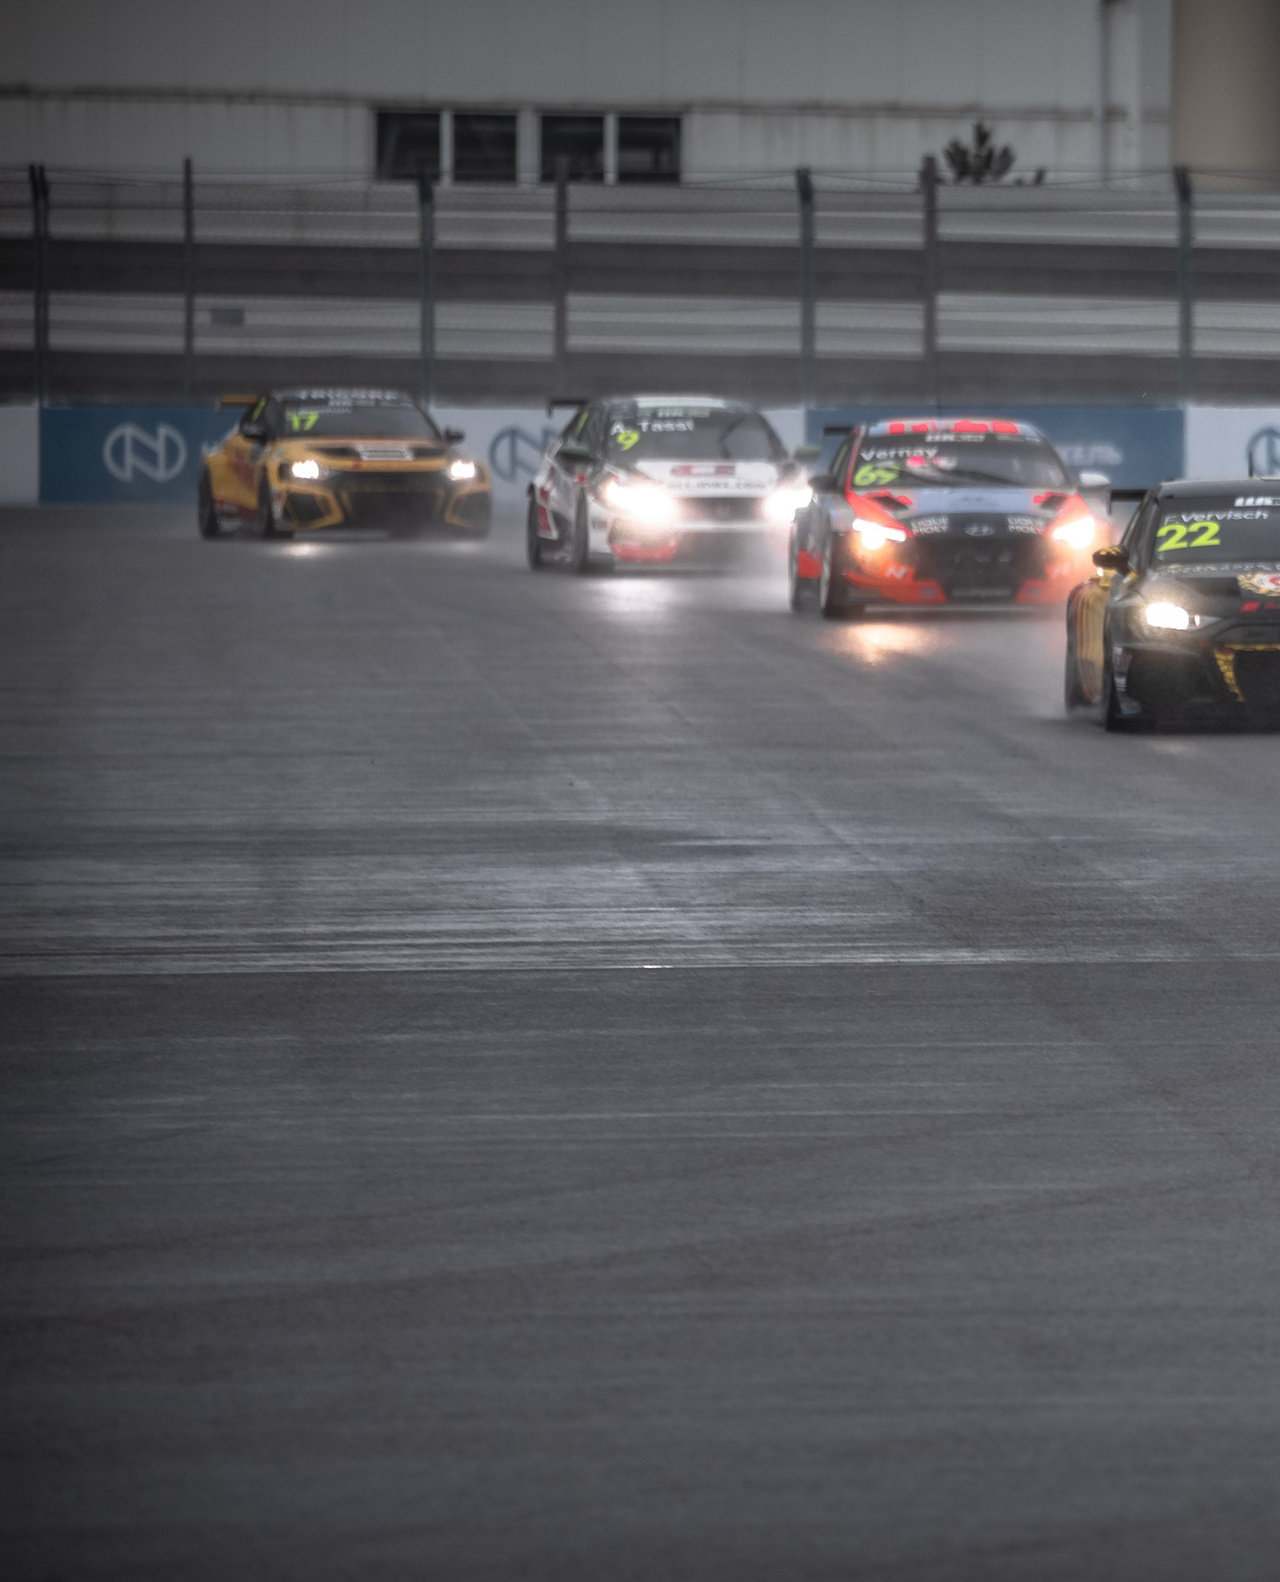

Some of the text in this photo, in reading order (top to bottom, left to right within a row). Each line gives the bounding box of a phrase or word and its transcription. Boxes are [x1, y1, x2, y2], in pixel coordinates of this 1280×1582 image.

[289, 413, 320, 432] 17
[637, 418, 694, 432] Tassi
[616, 430, 640, 451] 9
[860, 446, 937, 462] Vernay
[1156, 522, 1220, 551] 22
